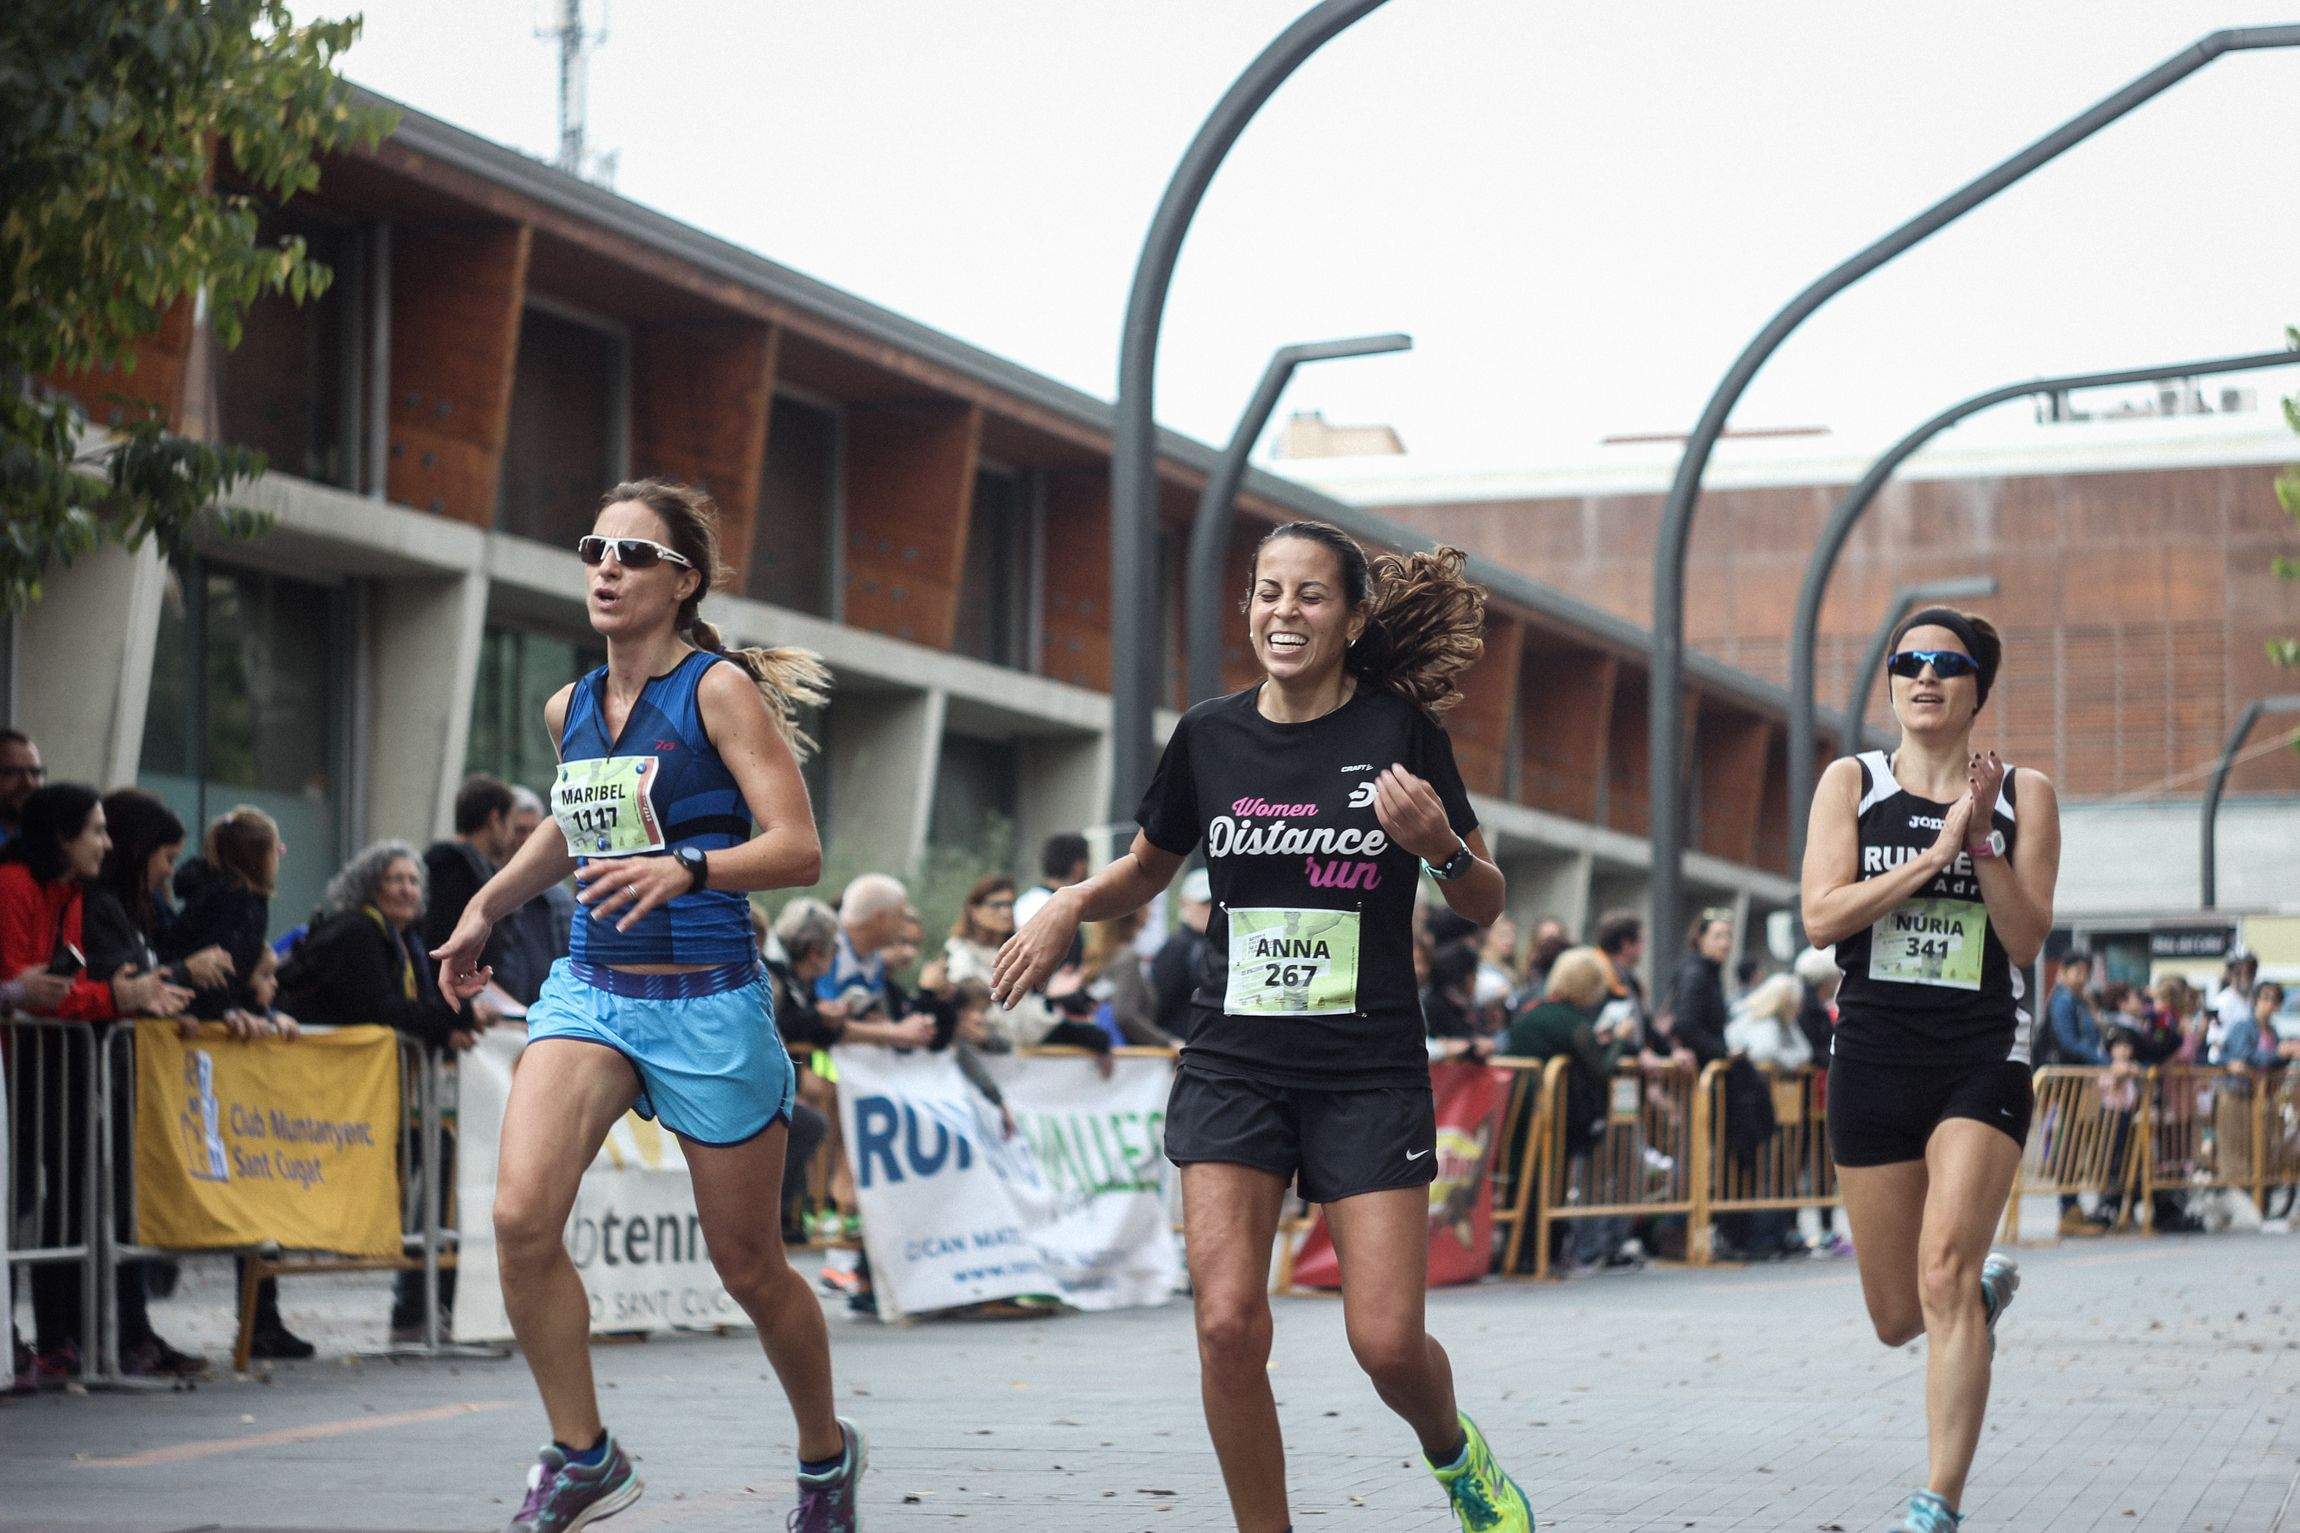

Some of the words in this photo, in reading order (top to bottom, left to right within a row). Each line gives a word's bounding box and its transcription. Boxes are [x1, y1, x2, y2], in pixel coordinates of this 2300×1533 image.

[561, 784, 626, 805] MARIBEL
[1232, 796, 1318, 817] Women
[573, 807, 617, 831] 1117
[1209, 815, 1388, 858] Distance
[1305, 856, 1382, 890] run
[1896, 912, 1964, 937] NÚRIA
[1255, 938, 1331, 959] ANNA
[1905, 937, 1950, 960] 341
[1265, 963, 1318, 987] 267
[230, 1102, 265, 1139] Club
[232, 1146, 273, 1180] Sant
[275, 1149, 324, 1190] Cugat
